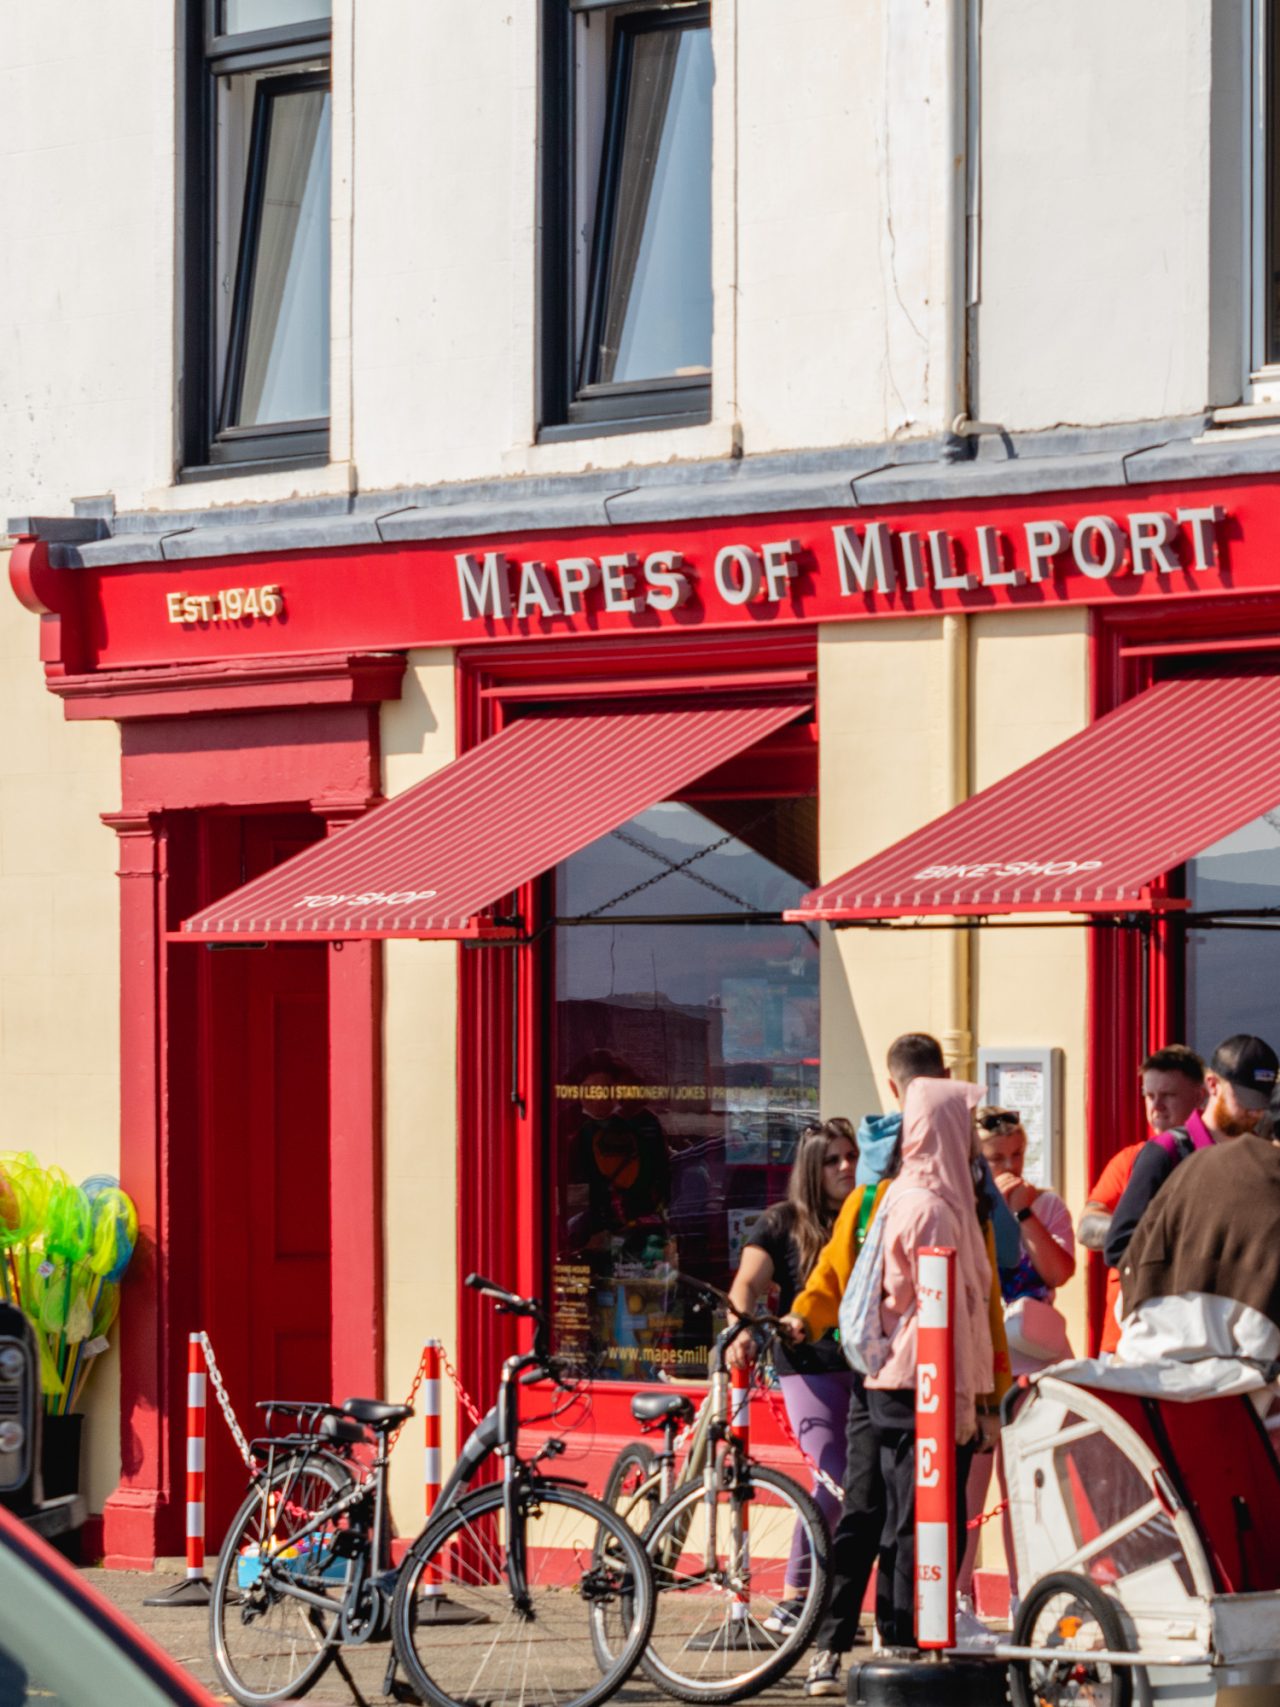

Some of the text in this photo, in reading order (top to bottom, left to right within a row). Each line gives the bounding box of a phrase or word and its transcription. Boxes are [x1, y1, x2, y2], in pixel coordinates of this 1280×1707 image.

[455, 506, 1220, 621] MAPES OF MILLPORT
[912, 860, 1104, 880] BIKE SHOP
[293, 889, 438, 909] TOY SHOP
[555, 1085, 579, 1099] TOYS
[584, 1085, 609, 1099] LEGO
[615, 1085, 671, 1100] STATIONERY
[675, 1085, 706, 1101] JOKES
[607, 1346, 709, 1365] www.mapesmill
